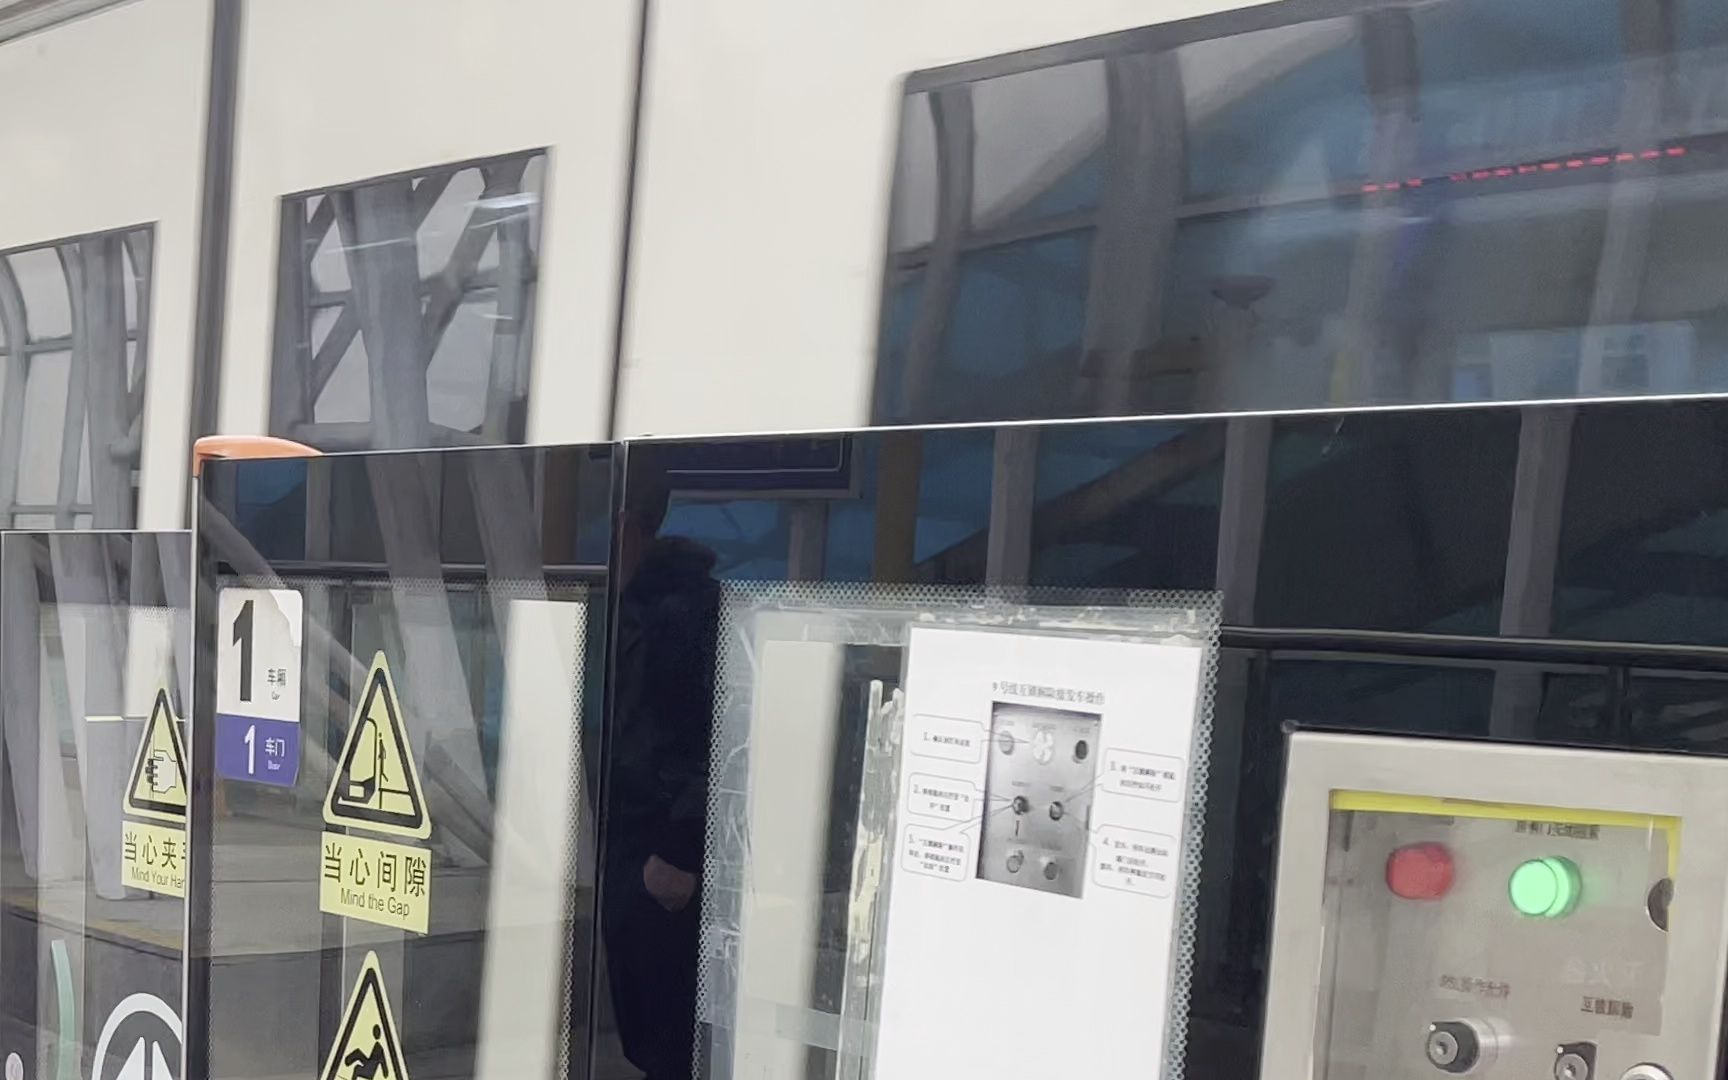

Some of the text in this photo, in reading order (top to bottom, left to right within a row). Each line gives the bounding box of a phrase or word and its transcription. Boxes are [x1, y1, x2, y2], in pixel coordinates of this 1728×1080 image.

[233, 599, 254, 702] 1
[244, 724, 256, 775] 1
[265, 736, 285, 757] 车门
[132, 866, 149, 882] Mind
[151, 870, 169, 886] Your
[324, 842, 427, 897] 当心间隙
[340, 887, 410, 920] Mind the Gap
